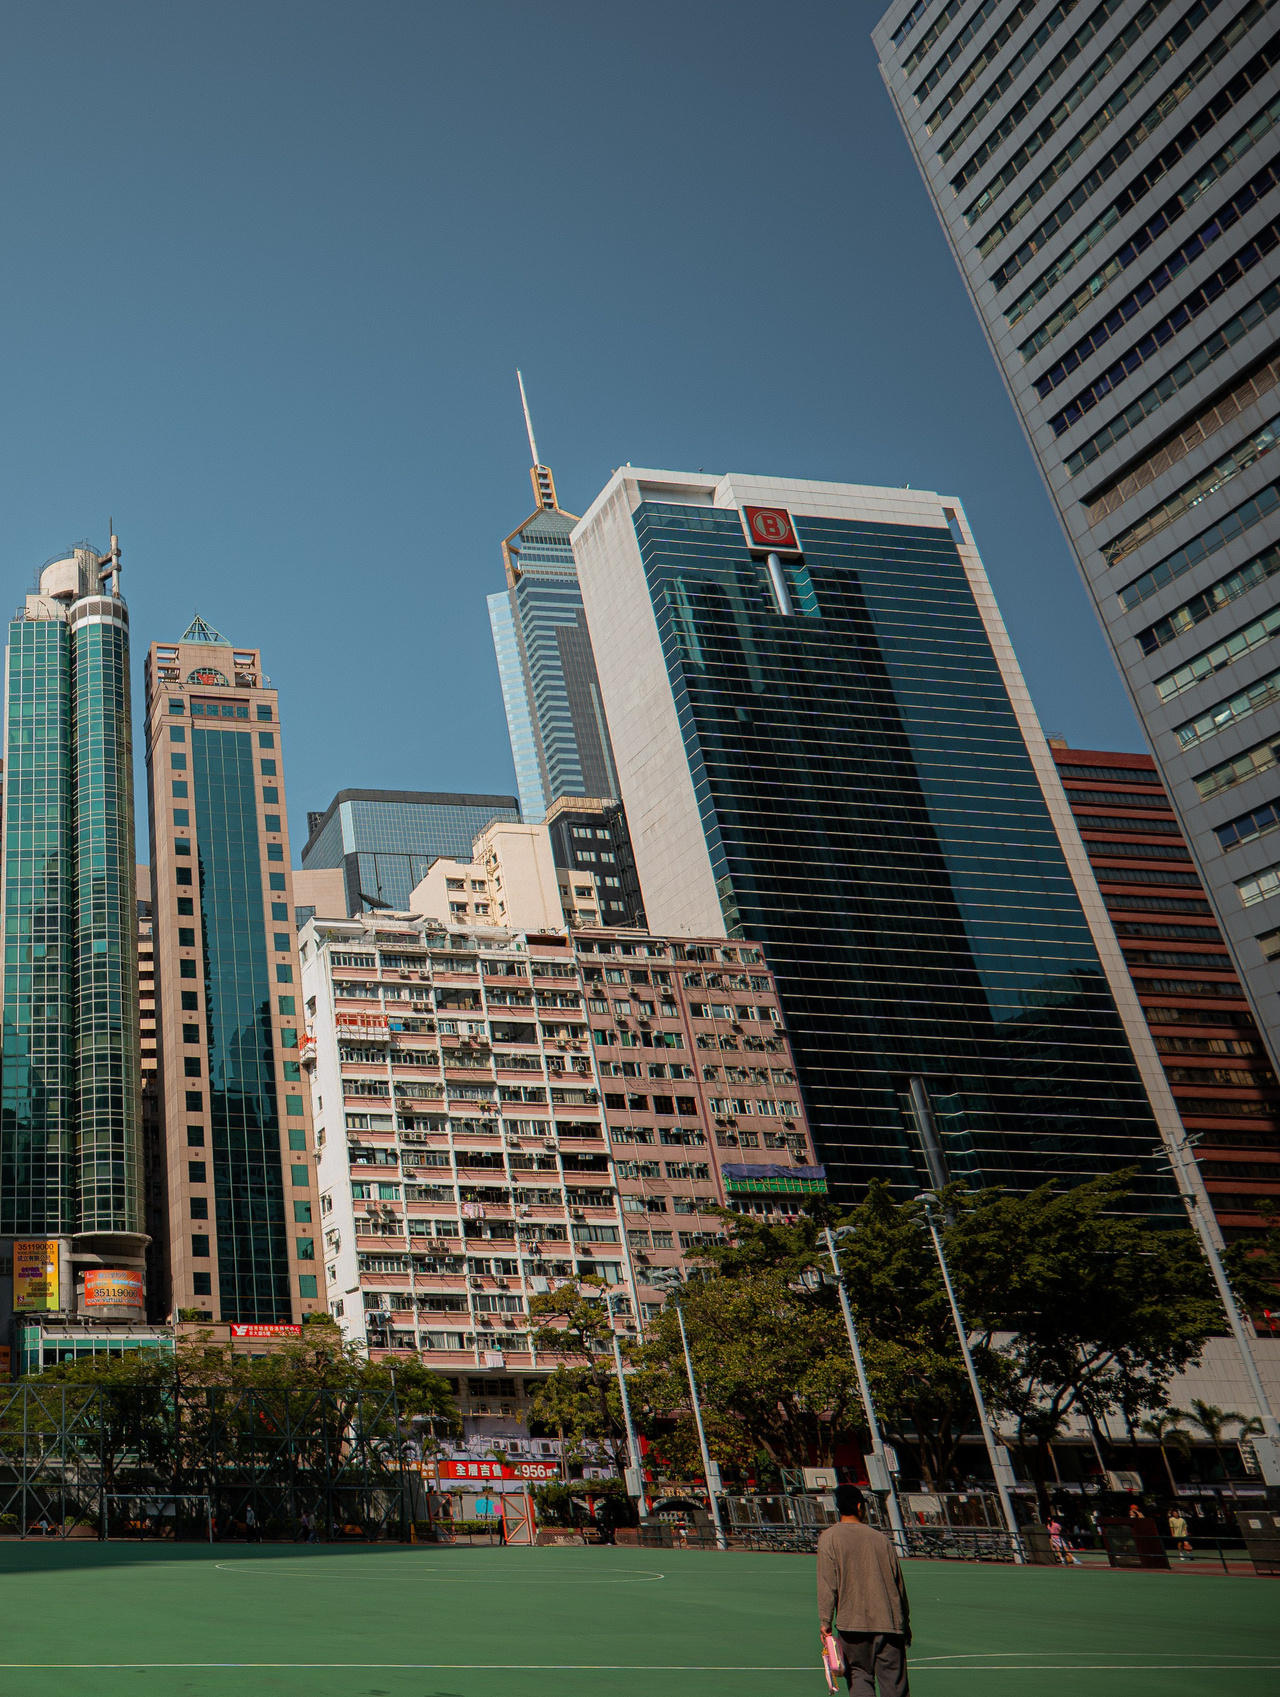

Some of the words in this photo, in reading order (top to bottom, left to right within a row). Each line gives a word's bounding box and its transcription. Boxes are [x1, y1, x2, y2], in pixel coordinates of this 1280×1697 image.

[17, 1243, 54, 1251] 35119000
[93, 1288, 138, 1298] 35119000
[233, 1324, 249, 1336] YE
